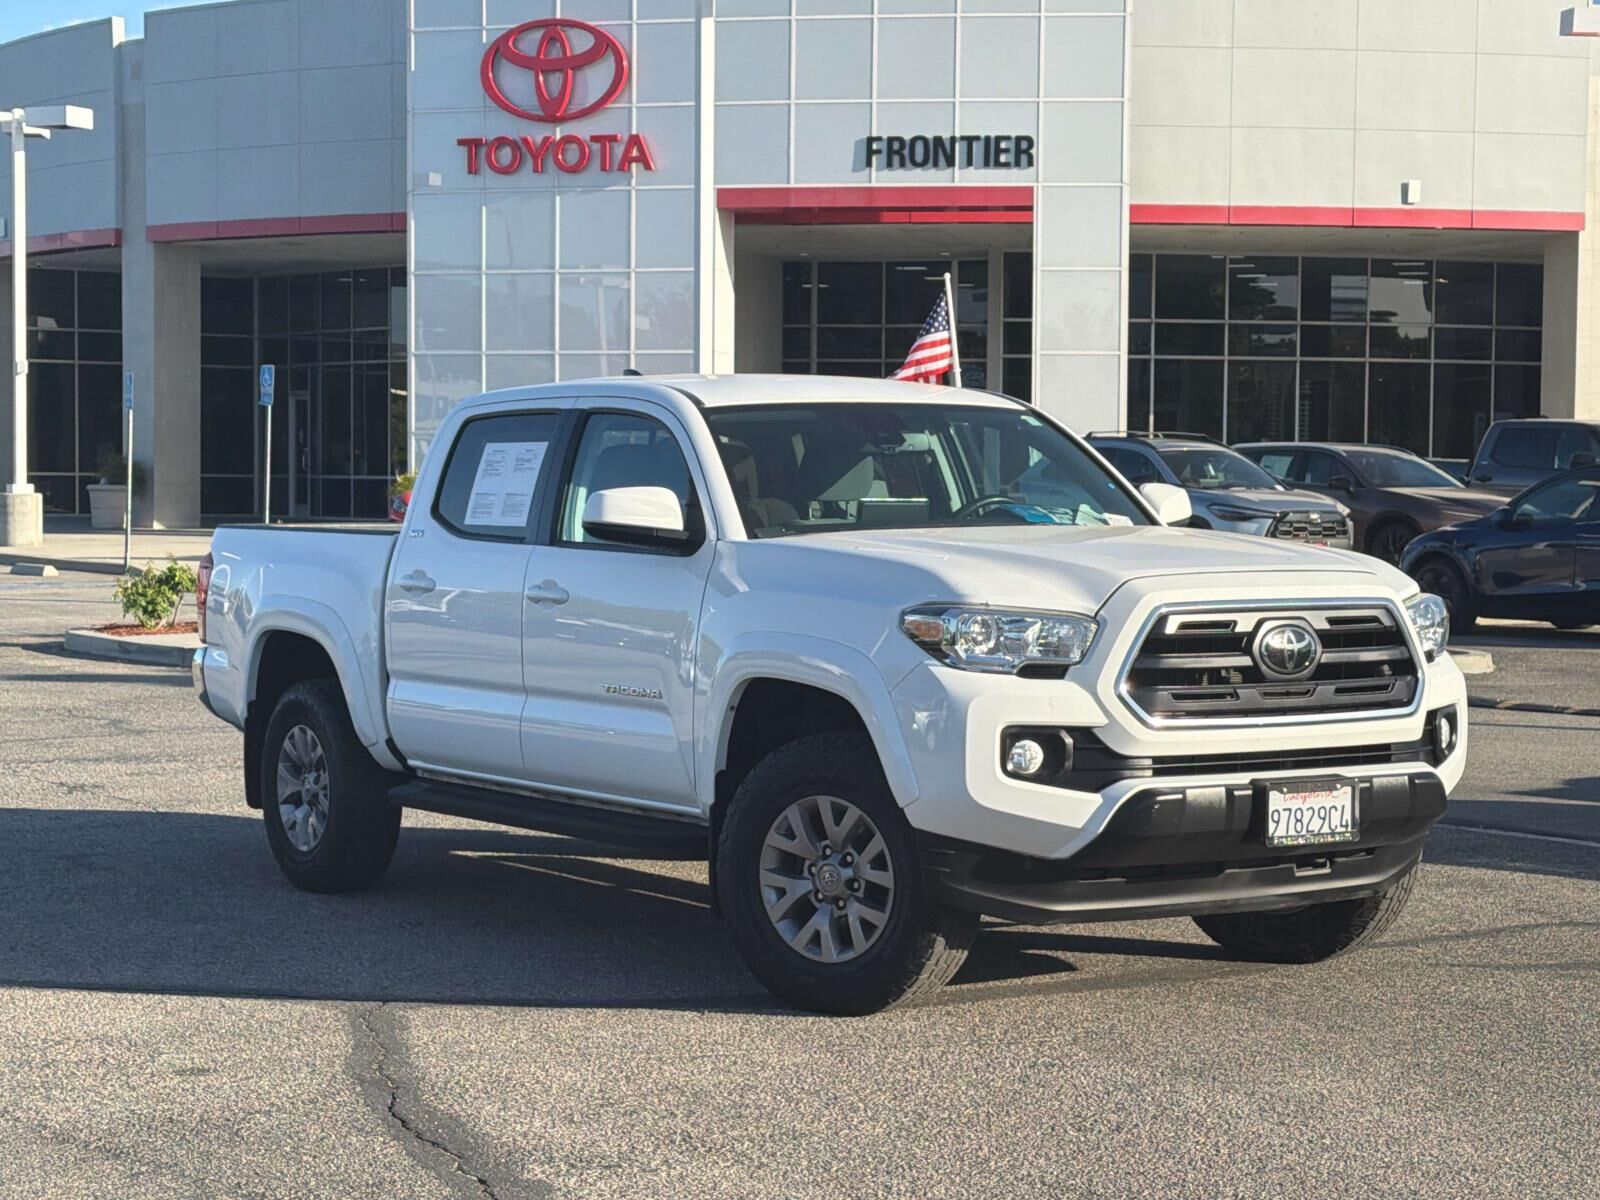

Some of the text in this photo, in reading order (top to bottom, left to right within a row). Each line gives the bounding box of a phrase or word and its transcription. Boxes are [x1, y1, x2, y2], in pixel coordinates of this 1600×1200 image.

[457, 134, 656, 175] TOYOTA
[865, 135, 1035, 168] FRONTIER
[602, 684, 663, 699] TACOMA
[1271, 804, 1350, 836] 97829C4
